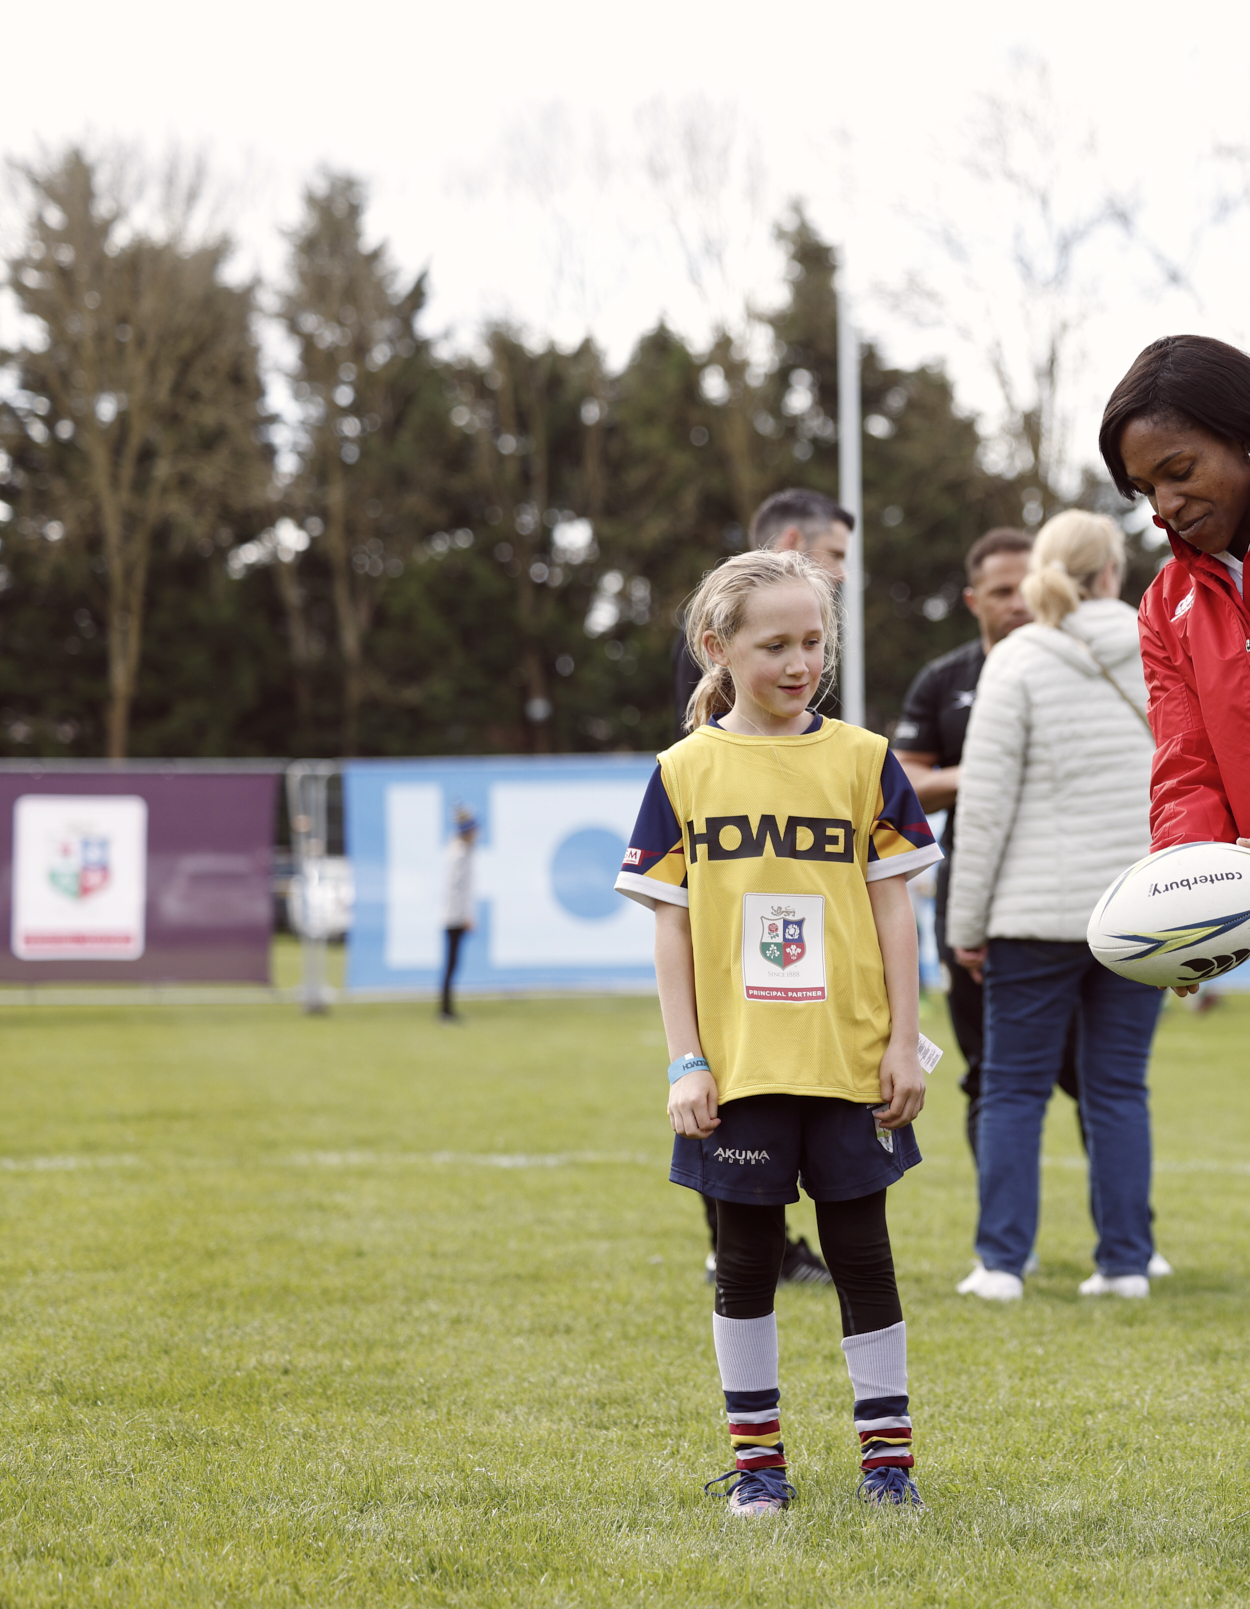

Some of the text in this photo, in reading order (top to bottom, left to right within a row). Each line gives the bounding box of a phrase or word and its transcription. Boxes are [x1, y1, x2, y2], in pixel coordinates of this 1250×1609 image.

[687, 814, 857, 864] HOWDE
[1152, 871, 1243, 897] canterbury
[748, 989, 823, 998] PRINCIPAL PARTNER
[713, 1147, 771, 1160] AKUMA
[718, 1155, 766, 1165] RUGBY
